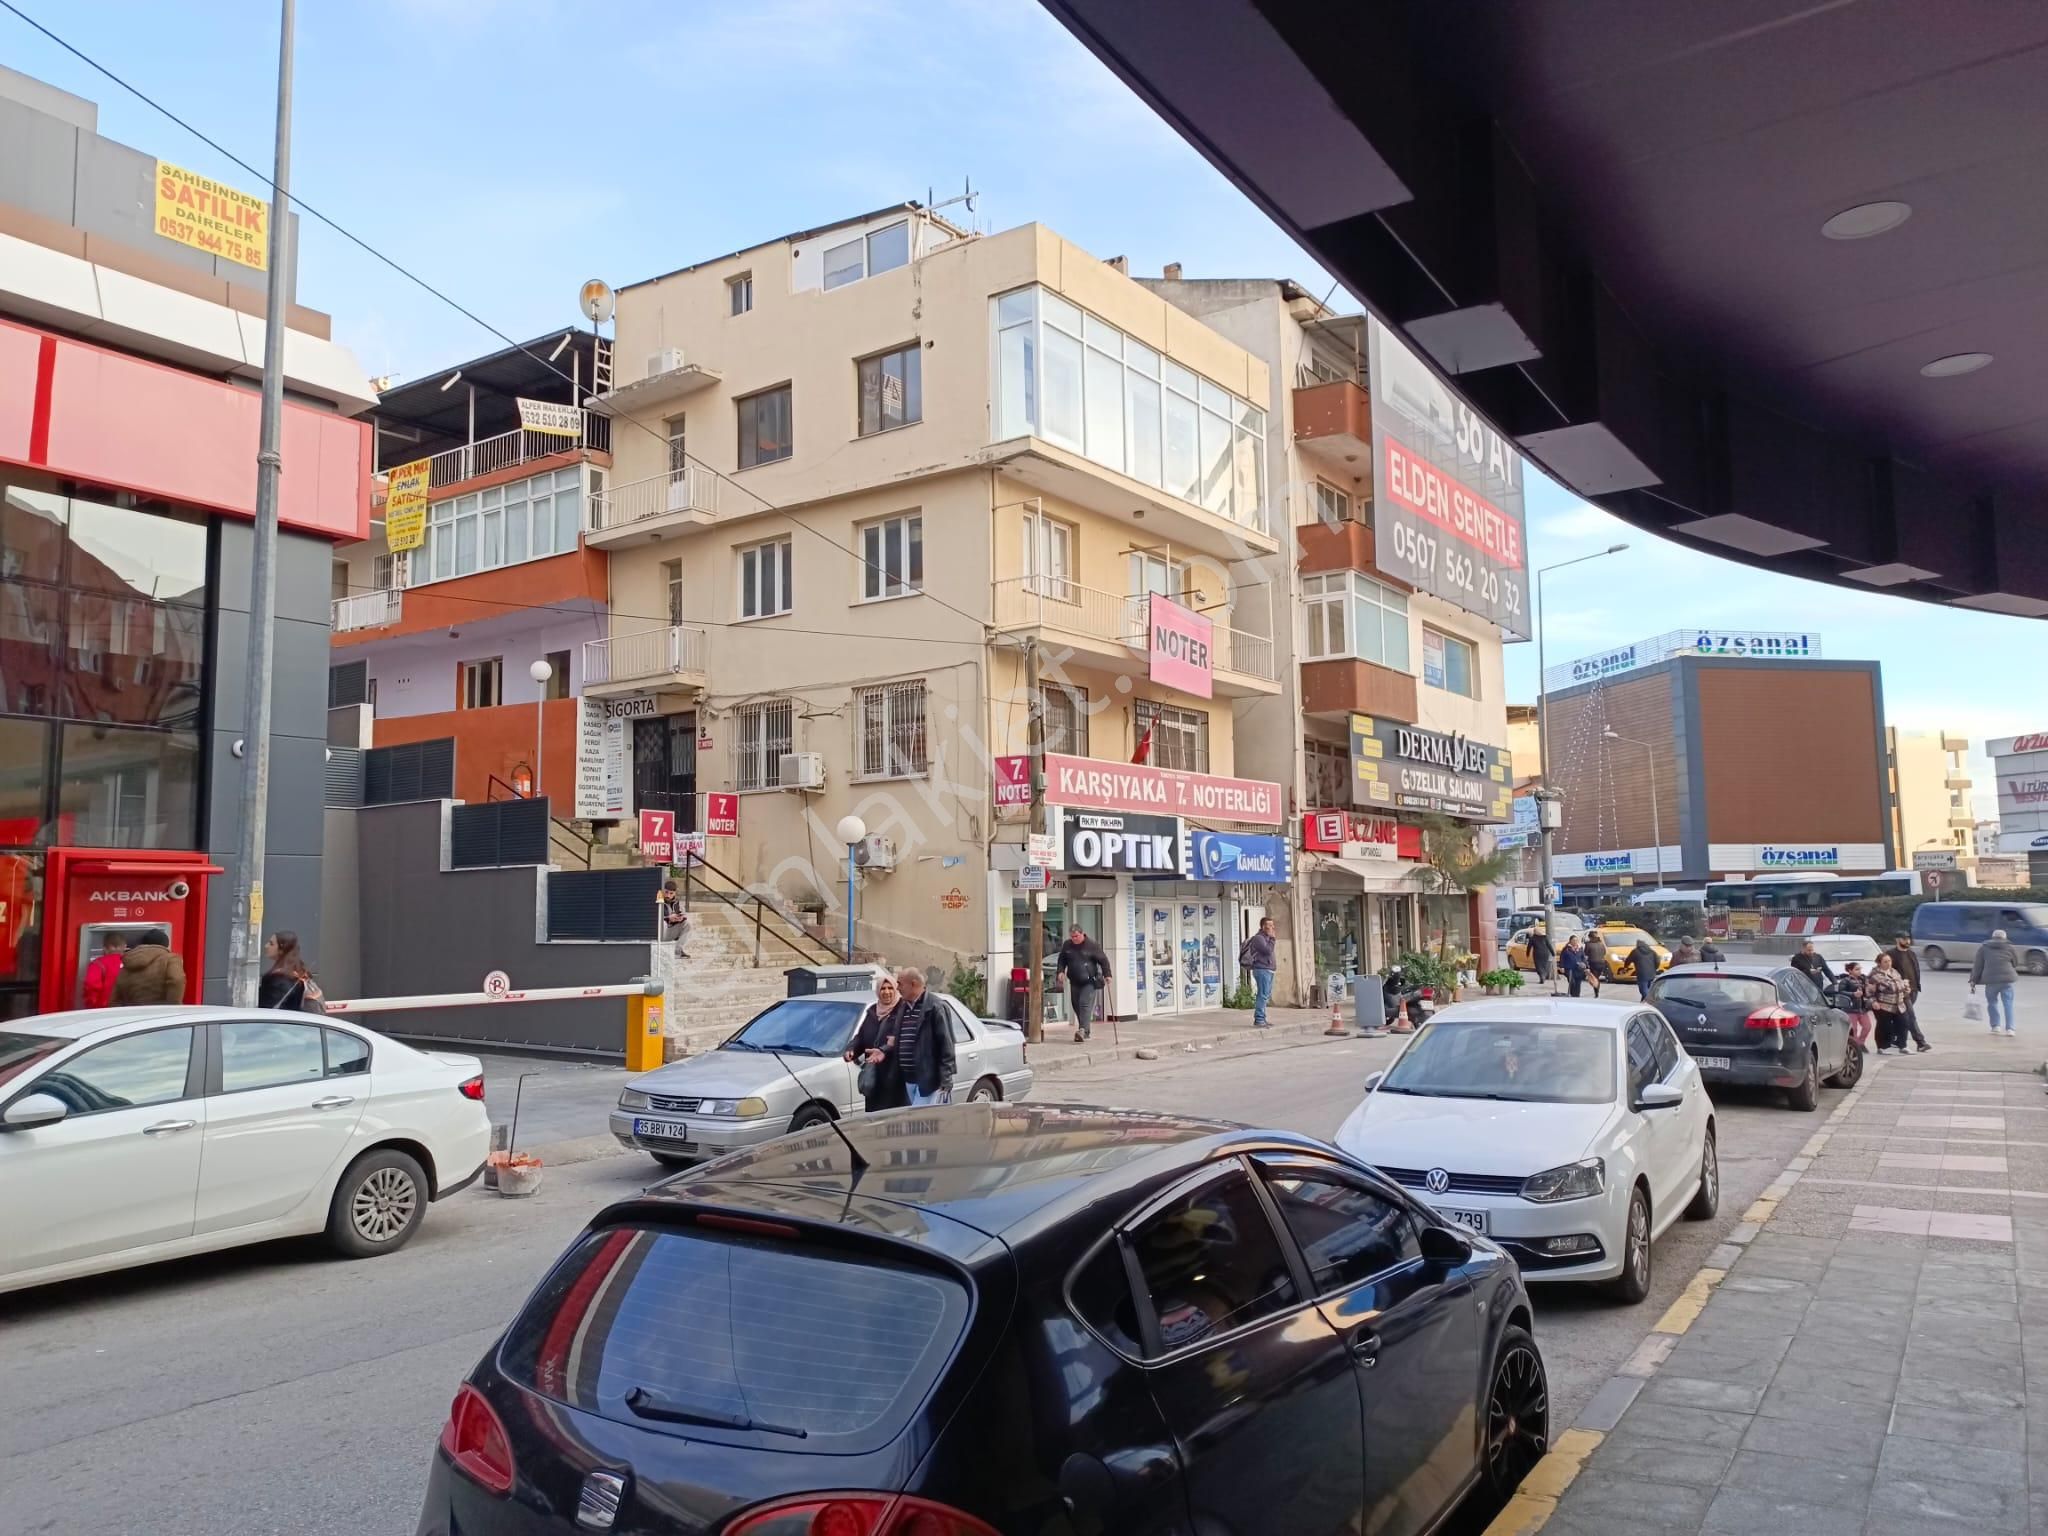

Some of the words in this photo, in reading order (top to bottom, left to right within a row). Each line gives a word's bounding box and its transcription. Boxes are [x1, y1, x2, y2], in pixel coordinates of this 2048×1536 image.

[161, 165, 261, 210] SAHİBİNDEN
[161, 177, 262, 233] SATILIK
[176, 207, 254, 242] DAİRELER
[160, 216, 193, 242] 0537
[197, 230, 222, 253] 944
[226, 240, 242, 260] 75
[246, 247, 261, 266] 85
[542, 412, 556, 427] 510
[559, 415, 568, 428] 28
[1390, 449, 1448, 523] ELDEN
[1454, 488, 1517, 562] SENETLE
[1393, 520, 1437, 573] 0507
[1446, 547, 1474, 592] 562
[1480, 566, 1498, 605] 20
[1504, 580, 1521, 615] 32
[1156, 625, 1208, 670] NOTER
[1697, 630, 1809, 656] özşanal
[606, 699, 655, 719] SİGORTA
[1011, 759, 1023, 780] 7.
[998, 783, 1031, 802] NOTE
[1060, 767, 1168, 805] KARŞIYAKA
[1176, 782, 1188, 806] 7.
[1193, 785, 1271, 814] NOTERLİĞİ
[1449, 777, 1483, 802] SALONU
[719, 798, 728, 815] 7.
[651, 816, 668, 838] 7.
[709, 818, 735, 832] NOTER
[1324, 820, 1338, 837] E
[643, 842, 671, 857] NOTER
[1761, 847, 1839, 867] özşanal
[1584, 852, 1632, 873] özşanal
[90, 891, 171, 901] AKBANK
[639, 1121, 649, 1133] 35
[650, 1122, 666, 1135] BBV
[669, 1125, 683, 1136] 124
[1454, 1212, 1483, 1230] 739
